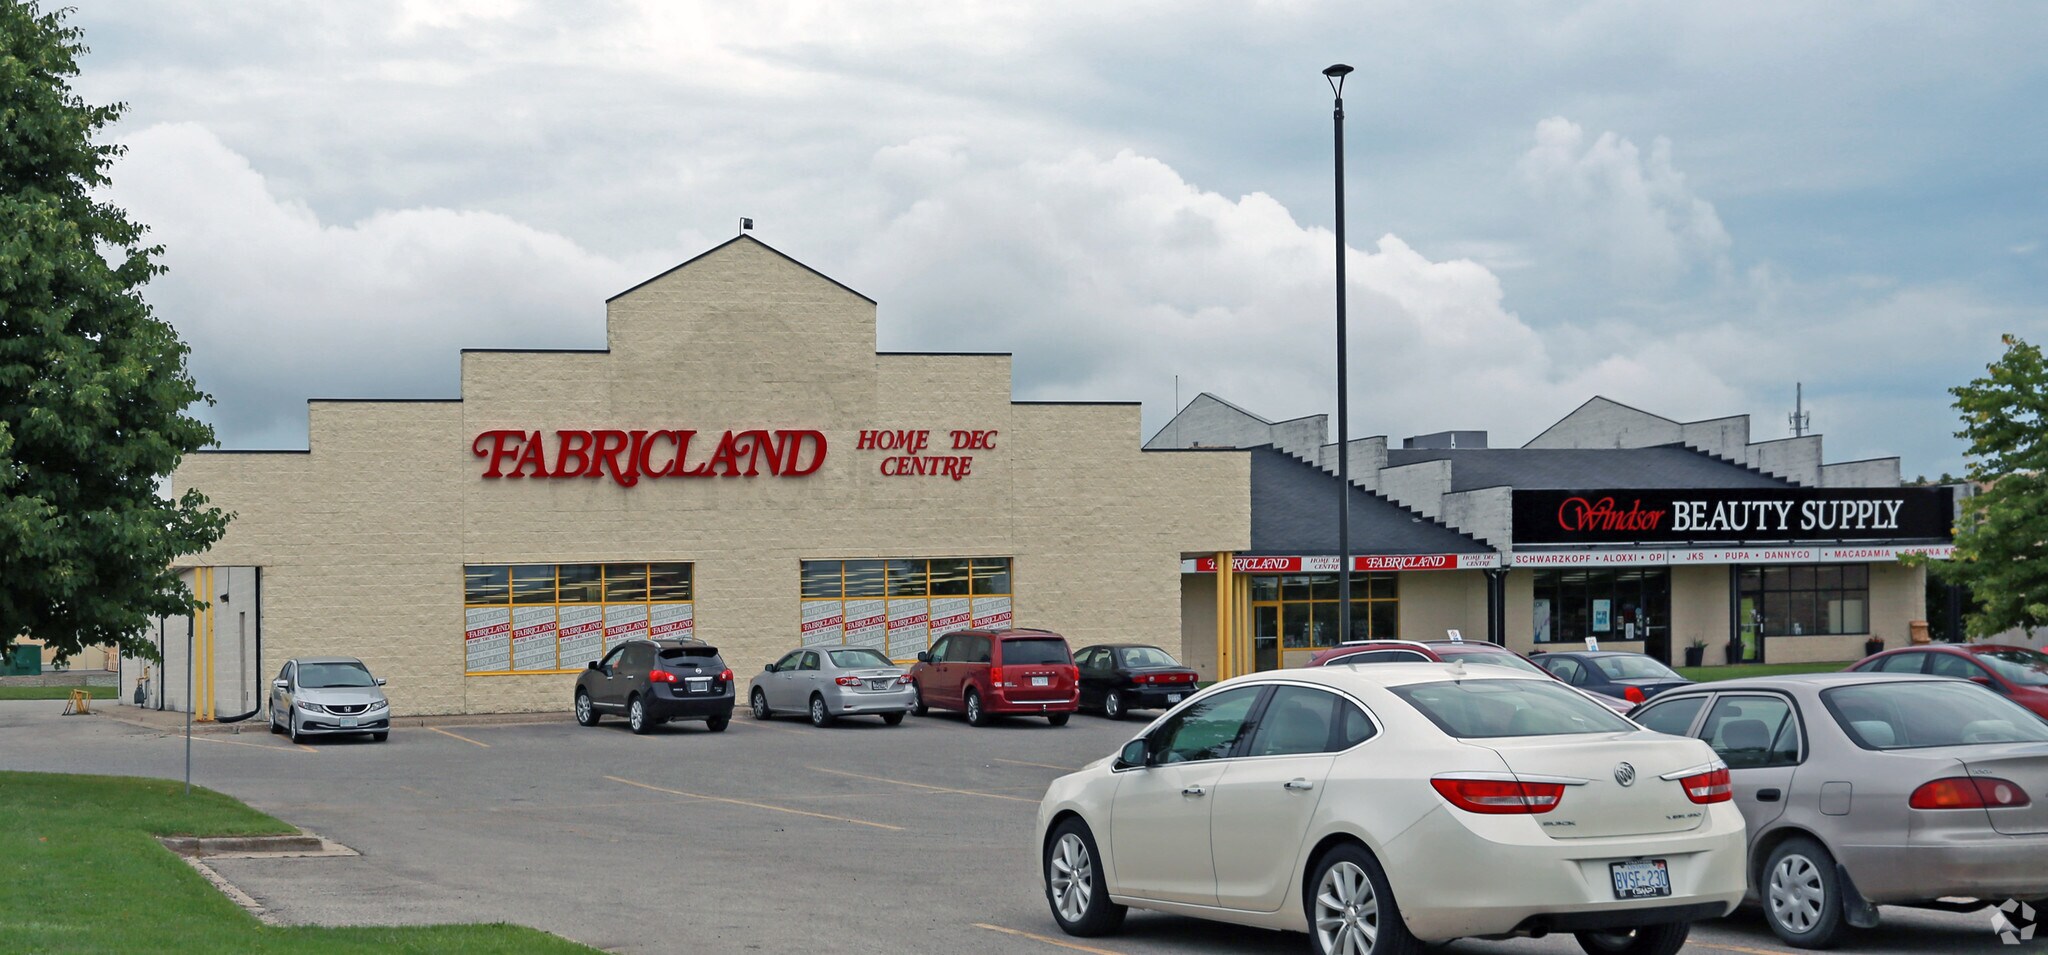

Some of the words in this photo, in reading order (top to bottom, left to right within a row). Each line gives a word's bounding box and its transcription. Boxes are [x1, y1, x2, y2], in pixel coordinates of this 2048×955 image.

[856, 430, 930, 454] HOME
[950, 430, 998, 450] DEC
[473, 430, 827, 487] FABRICLAND
[880, 456, 973, 481] CENTRE
[1558, 496, 1667, 532] Windsor
[1672, 500, 1795, 531] BEAUTY
[1800, 500, 1904, 530] SUPPLY
[1366, 555, 1446, 569] FABRICLAND
[1515, 554, 1591, 563] SCHWARZKOPF
[1603, 553, 1637, 562] ALOXXI
[1649, 553, 1665, 561] OPI
[1686, 552, 1704, 560] JKS
[1725, 552, 1750, 560] PUPA
[1764, 551, 1810, 559] DANNYCO
[1834, 549, 1891, 558] MACADAMIA
[1207, 557, 1289, 571] FRICLAND
[803, 616, 842, 631] FABRICLAND
[846, 615, 885, 630] FABRICLAND
[889, 614, 927, 629] FABRICLAND
[931, 613, 970, 628] FABRICLAND
[973, 612, 1011, 627] FABRICLAND
[467, 623, 510, 638] FABRICLAND
[514, 622, 556, 638] FABRICLAND
[560, 622, 602, 637] FABRICLAND
[606, 620, 648, 635] FABRICLAND
[651, 620, 693, 635] FABRICLAND
